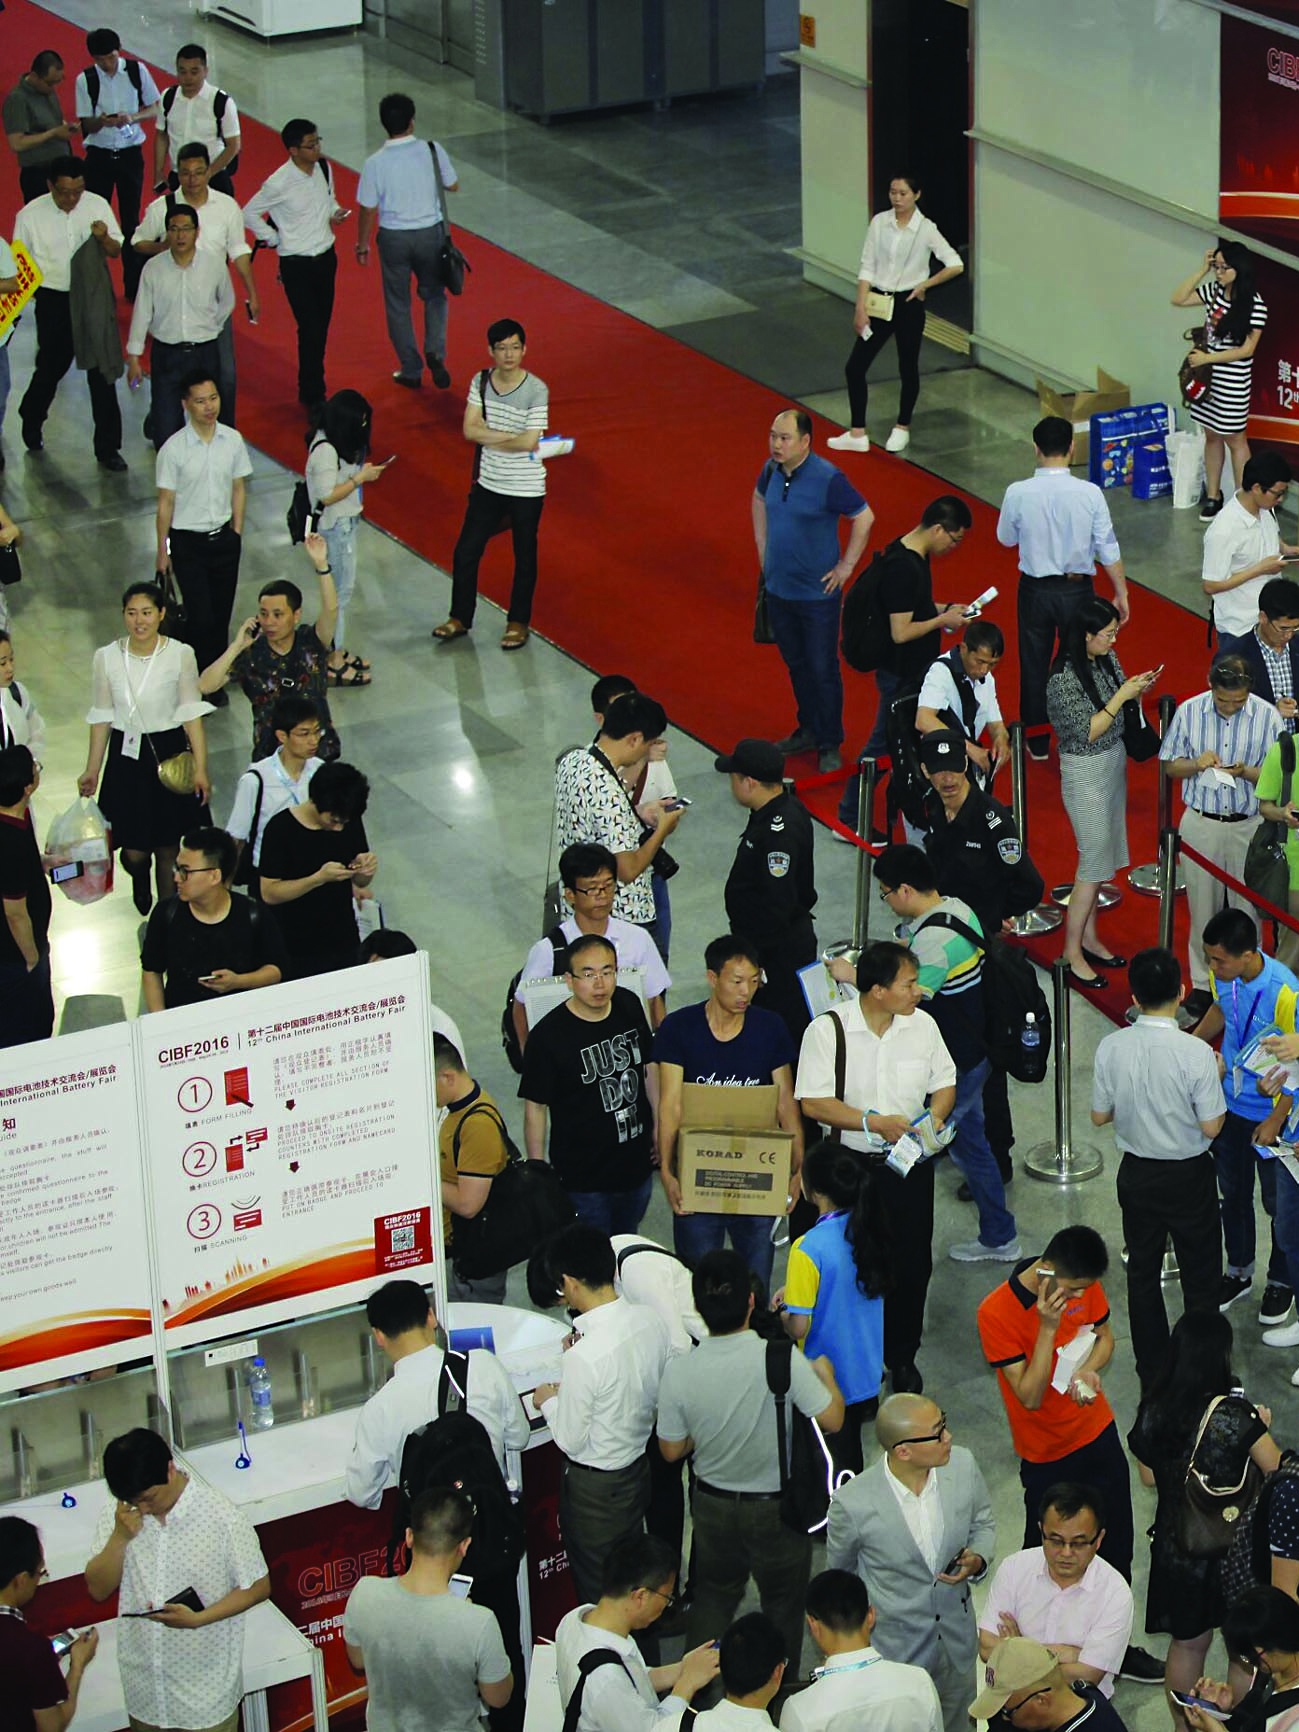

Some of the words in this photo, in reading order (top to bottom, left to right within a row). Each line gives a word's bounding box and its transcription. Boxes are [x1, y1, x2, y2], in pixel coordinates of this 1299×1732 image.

[247, 994, 406, 1040] 第十二届中国国际电池技术交流会/展览会
[265, 1032, 292, 1044] China
[294, 1017, 351, 1037] International
[353, 1009, 386, 1023] Battery
[388, 1005, 406, 1016] Fair
[158, 1036, 230, 1064] CIBF2016
[580, 1028, 642, 1084] JUST
[0, 1088, 60, 1107] International
[62, 1079, 96, 1093] Battery
[99, 1075, 117, 1085] Fair
[190, 1083, 198, 1103] 1
[599, 1068, 639, 1113] DO
[2, 1118, 16, 1132] 知
[201, 1114, 223, 1125] FORM
[224, 1108, 253, 1119] FILLING
[193, 1148, 206, 1169] 2
[696, 1149, 744, 1160] KORAD
[202, 1170, 255, 1188] REGISTRATION
[198, 1210, 211, 1232] 3
[384, 1211, 421, 1225] CIBF2016
[210, 1235, 248, 1248] SCANNING
[538, 1550, 568, 1571] 第十二
